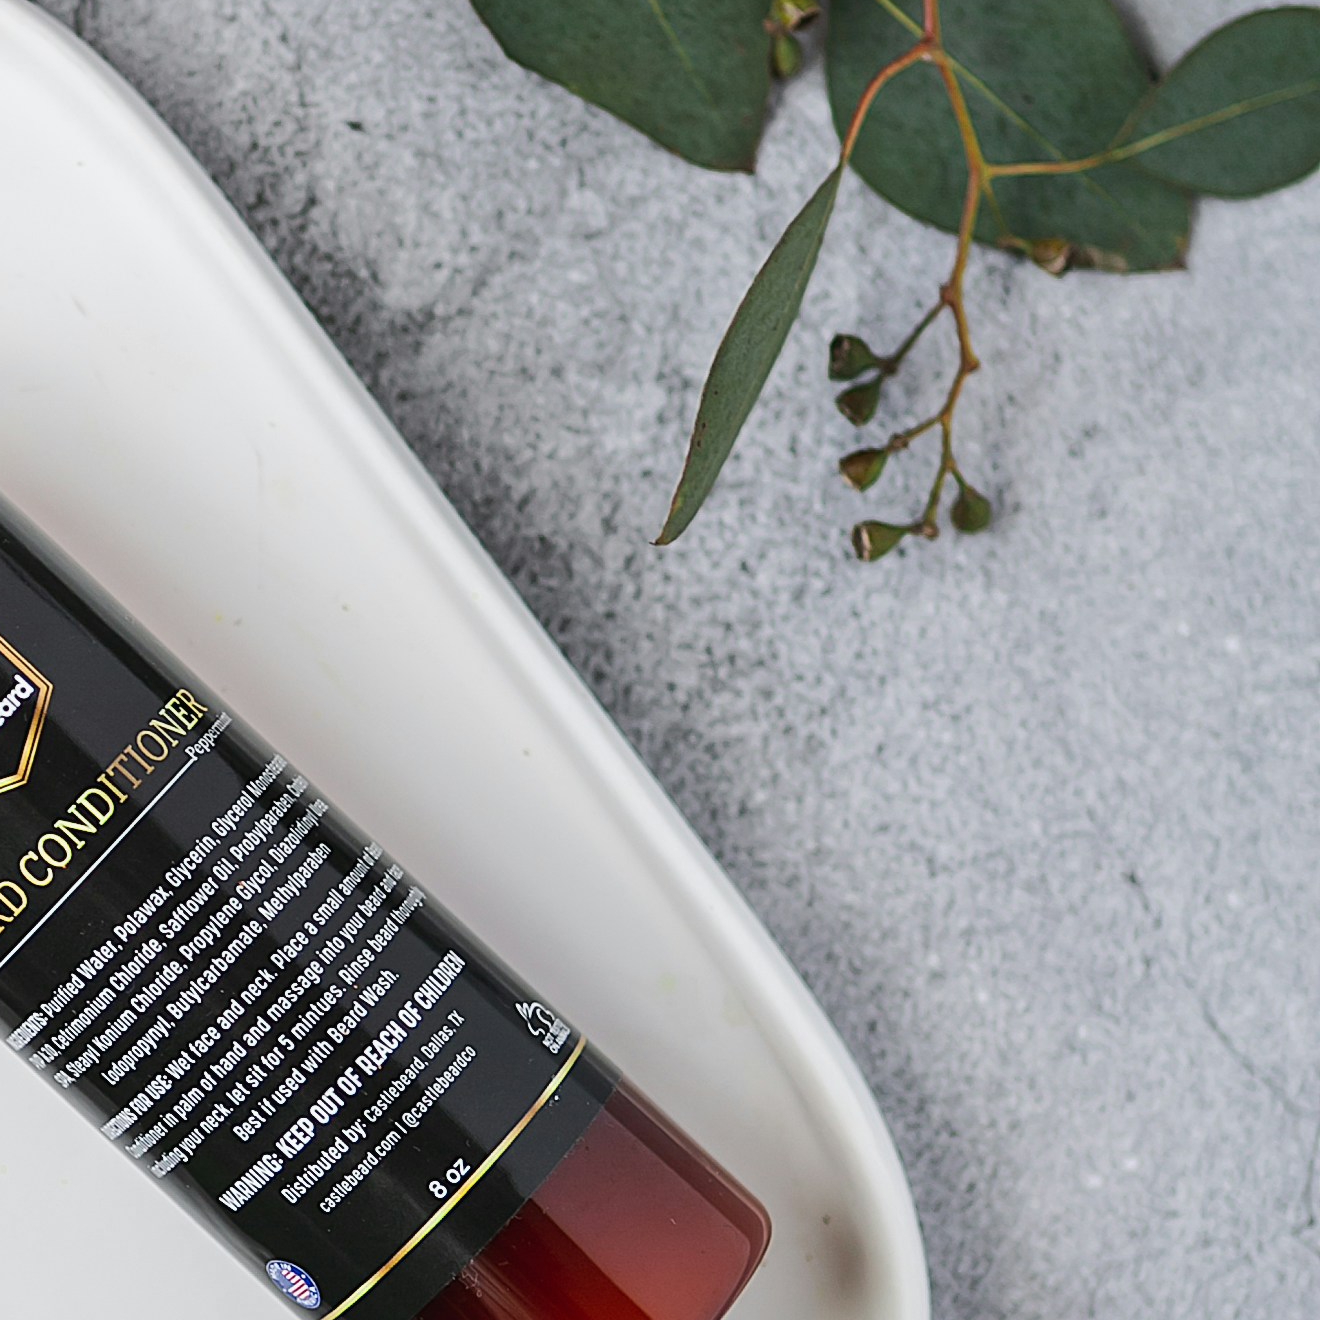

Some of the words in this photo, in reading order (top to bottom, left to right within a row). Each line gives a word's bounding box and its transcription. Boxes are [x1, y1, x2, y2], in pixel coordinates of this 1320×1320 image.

[19, 688, 208, 886] CONDITIONER
[183, 709, 233, 761] Peppermint
[39, 973, 85, 1018] Purified
[75, 940, 123, 979] Water,
[113, 885, 173, 942] Polawax,
[165, 836, 221, 887] Glycerin,
[211, 790, 255, 836] Glycerol
[50, 987, 117, 1049] Cetrimonium
[109, 938, 167, 991] Chloride,
[158, 876, 219, 939] Safflower
[212, 857, 239, 880] Oil,
[65, 1043, 100, 1077] Stearyl
[91, 1009, 137, 1051] Konium
[130, 960, 188, 1012] Chloride,
[178, 897, 242, 961] Propylene
[235, 858, 278, 900] Glycol,
[268, 808, 319, 863] Diazolidinyl
[128, 1092, 154, 1115] FOR
[144, 1074, 172, 1100] USE:
[164, 1050, 195, 1079] Wet
[188, 1026, 221, 1057] face
[216, 998, 245, 1029] and
[240, 968, 278, 1004] neck.
[270, 931, 309, 969] Place
[303, 921, 318, 935] a
[312, 888, 344, 925] small
[338, 857, 370, 895] amount
[362, 850, 375, 866] of
[159, 1112, 179, 1127] in
[172, 1087, 205, 1120] palm
[199, 1070, 217, 1091] of
[209, 1040, 247, 1078] hand
[242, 1015, 271, 1046] and
[266, 960, 323, 1021] massage
[315, 936, 345, 964] into
[338, 911, 366, 943] your
[357, 885, 386, 917] beard
[379, 871, 397, 893] and
[165, 920, 268, 1019] Butylcarbamate,
[257, 843, 331, 921] Methylparaben
[178, 1128, 205, 1156] your
[199, 1103, 233, 1134] neck.
[245, 1064, 267, 1087] sit
[260, 1046, 285, 1070] for
[277, 1033, 295, 1050] 5
[290, 984, 346, 1040] mintues.
[338, 948, 375, 985] Rinse
[366, 917, 399, 952] beard
[218, 1153, 283, 1211] WARNING:
[275, 1117, 314, 1158] KEEP
[309, 1086, 344, 1124] OUT
[336, 1066, 362, 1095] OF
[354, 1020, 407, 1075] REACH
[398, 1000, 421, 1028] OF
[413, 949, 465, 1009] CHILDREN
[232, 1109, 266, 1141] Best
[257, 1097, 276, 1116] if
[271, 1067, 306, 1104] used
[300, 1040, 334, 1073] with
[326, 1000, 367, 1043] Beard
[358, 970, 399, 1006] Wash.
[280, 1136, 349, 1203] Distributed
[341, 1118, 366, 1142] by:
[363, 1056, 429, 1122] Castlebeard,
[447, 1009, 464, 1026] TX
[319, 1130, 401, 1212] castlebeard.com
[401, 1045, 476, 1127] @castlebeardco
[428, 1180, 447, 1198] 8
[445, 1157, 470, 1183] oz
